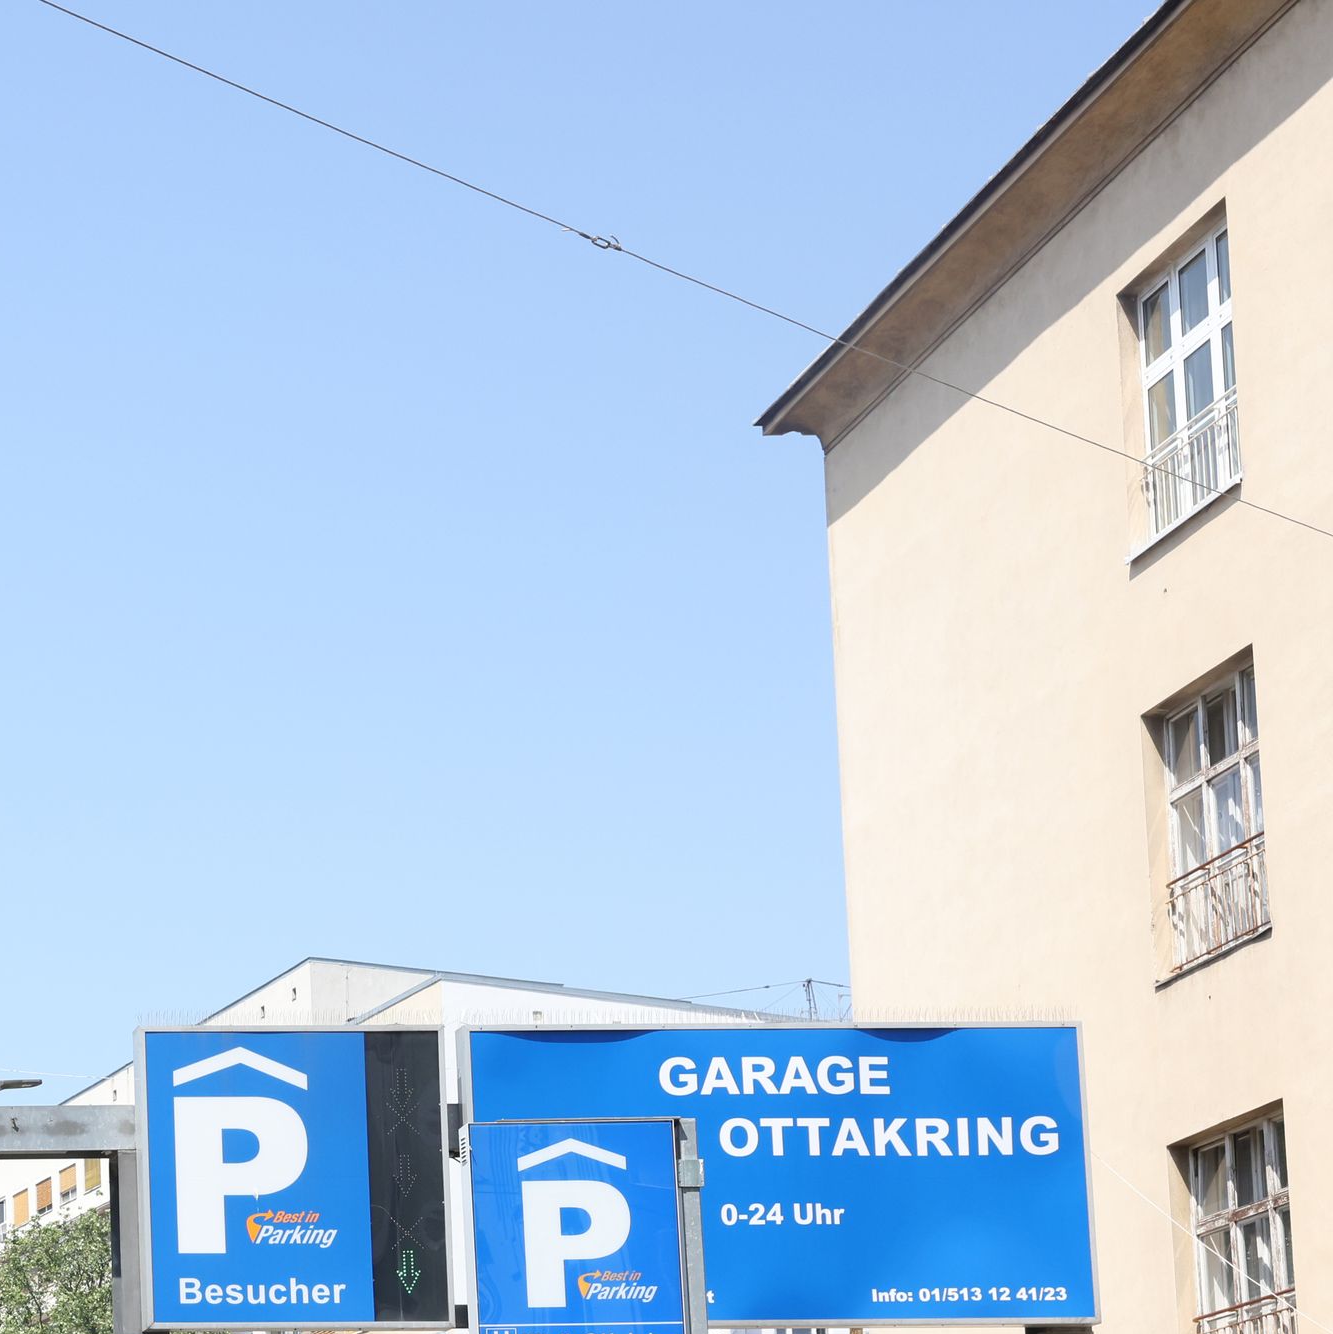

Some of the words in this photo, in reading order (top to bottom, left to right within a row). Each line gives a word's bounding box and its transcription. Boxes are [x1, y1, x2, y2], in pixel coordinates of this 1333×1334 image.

[658, 1055, 891, 1096] GARAGE
[719, 1115, 1059, 1157] OTTAKRING
[173, 1096, 309, 1254] P
[273, 1210, 305, 1223] Best
[305, 1210, 320, 1223] in
[720, 1202, 784, 1226] 0-24
[793, 1202, 845, 1225] Uhr
[255, 1225, 338, 1249] Parking
[520, 1180, 632, 1308] P
[601, 1270, 630, 1281] Best
[629, 1270, 642, 1281] in
[179, 1277, 346, 1305] Besucher
[585, 1282, 658, 1303] Parking
[871, 1288, 914, 1302] Info:
[918, 1287, 983, 1302] 01/513
[988, 1287, 1011, 1301] 12
[1016, 1286, 1068, 1301] 41/23
